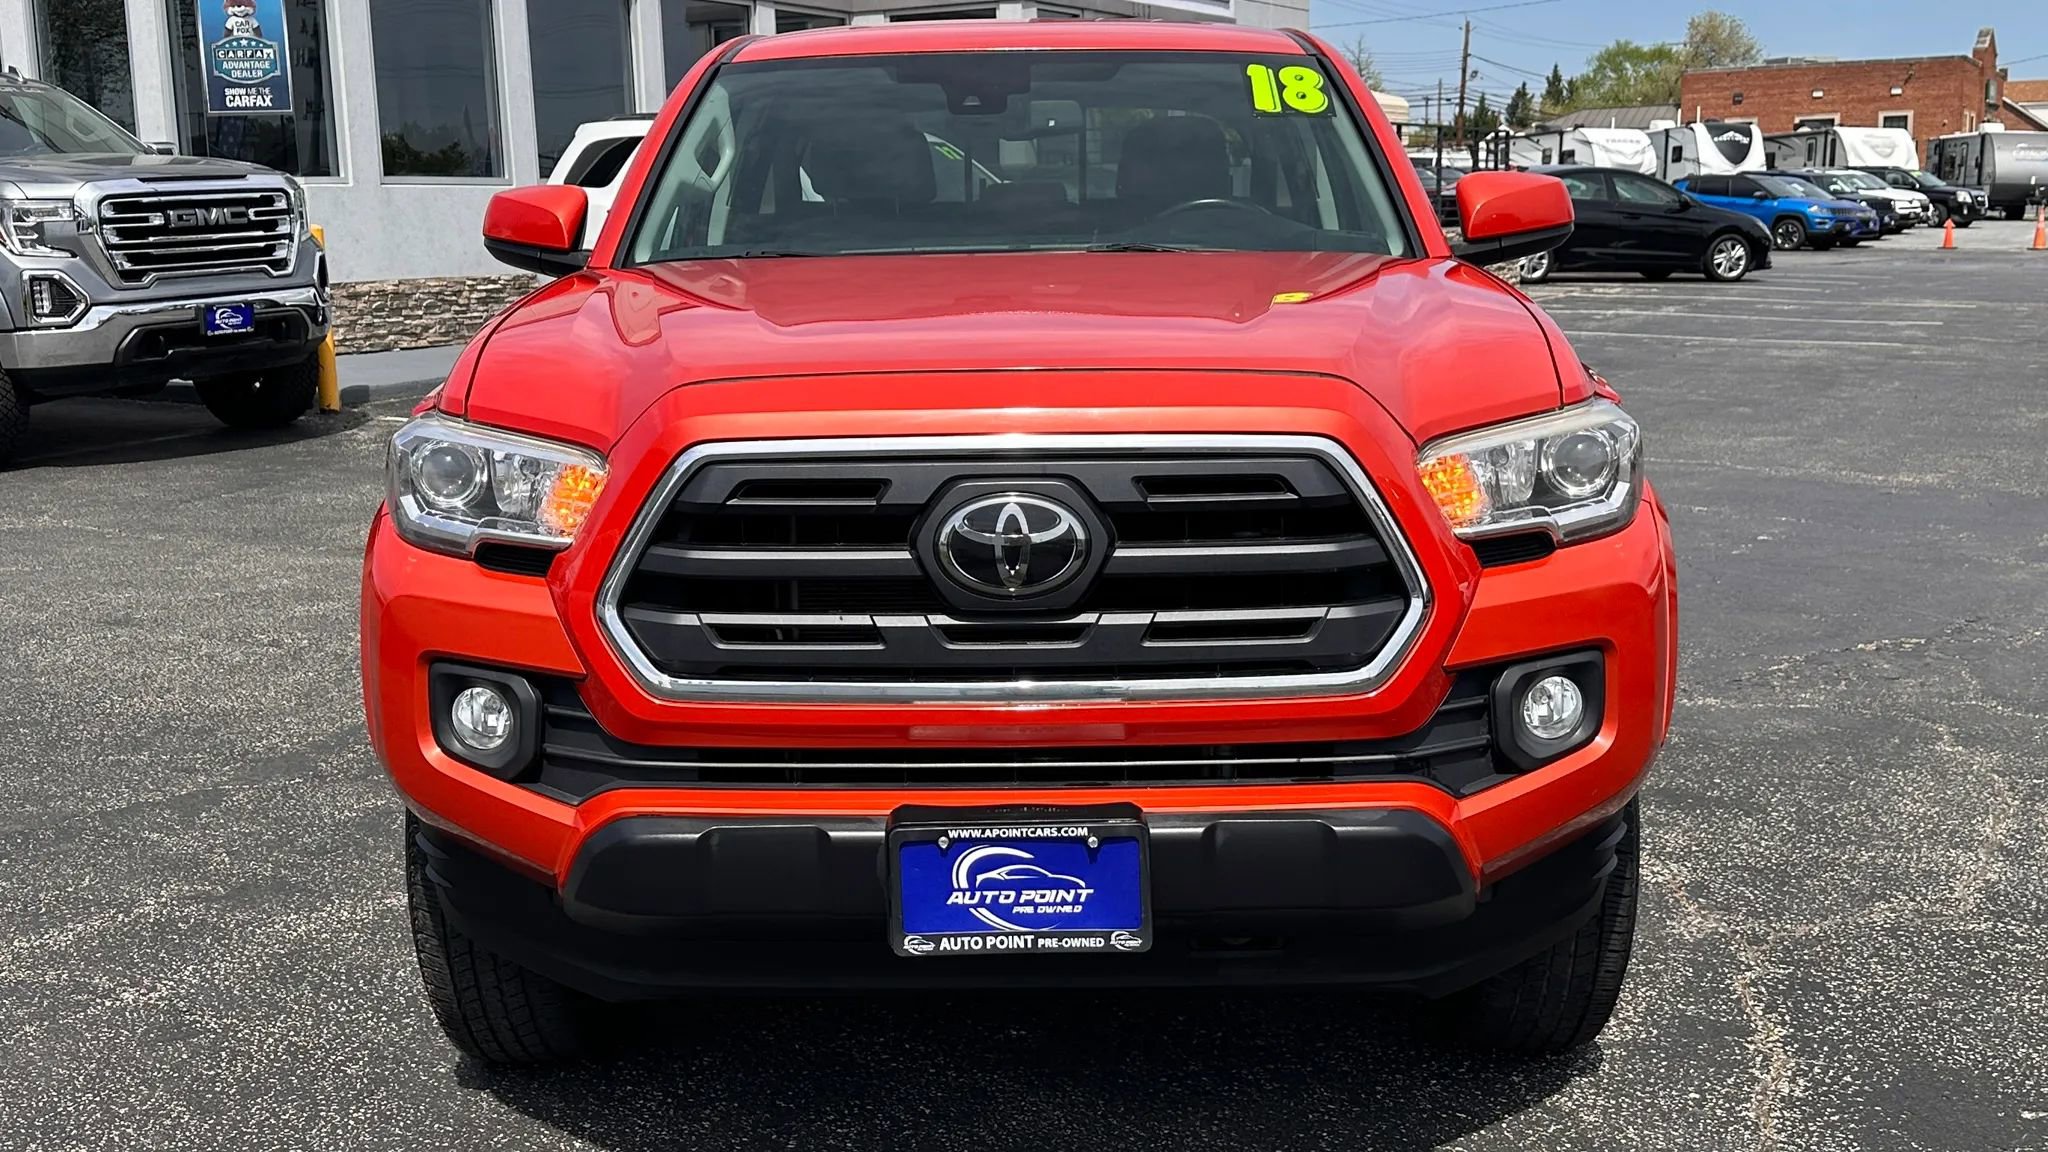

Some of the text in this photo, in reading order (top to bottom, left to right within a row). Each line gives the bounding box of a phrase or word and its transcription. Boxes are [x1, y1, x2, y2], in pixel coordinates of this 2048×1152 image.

[235, 20, 250, 28] CAR
[217, 49, 274, 59] CARFAX
[222, 61, 271, 70] ADVANTAGE
[231, 70, 263, 78] DEALER
[224, 87, 272, 96] SHOW ME THE
[1246, 64, 1329, 113] 18
[225, 95, 273, 108] CARFAX
[168, 206, 248, 228] GMC
[947, 826, 1089, 839] WWW.APOINTCARS.COM
[946, 888, 1095, 905] AUTO POINT
[1011, 904, 1083, 914] PRE OWNED
[939, 934, 1105, 951] AUTO POINT PRE-OWNED
